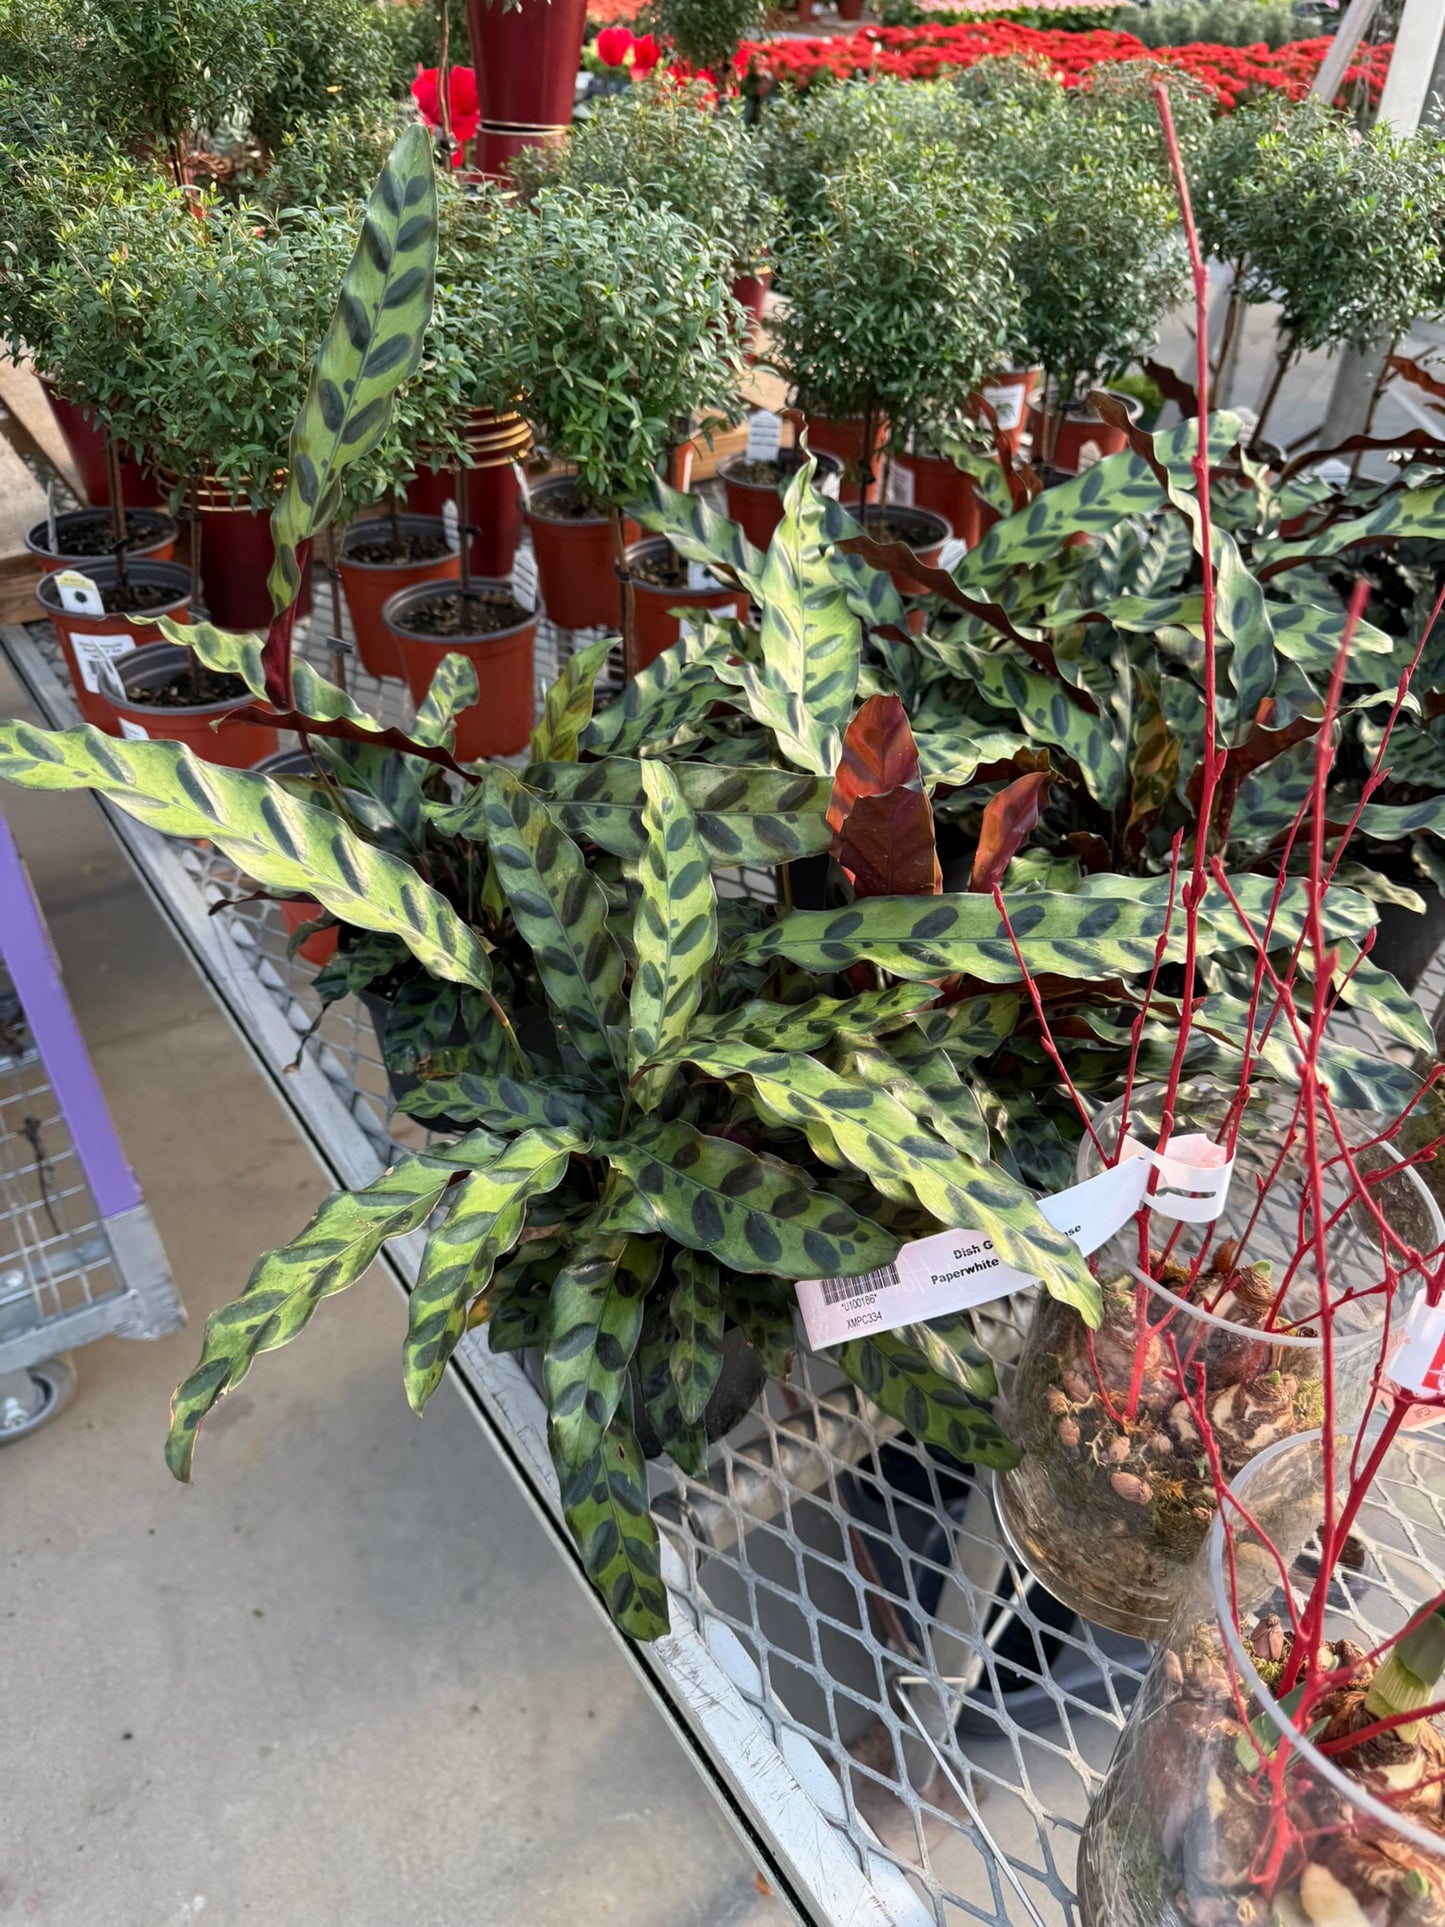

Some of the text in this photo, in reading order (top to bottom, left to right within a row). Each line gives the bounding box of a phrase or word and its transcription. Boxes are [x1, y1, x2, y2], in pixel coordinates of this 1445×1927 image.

[953, 1245, 981, 1259] Dish
[930, 1258, 1000, 1285] Paperwhite
[846, 1310, 883, 1330] XMPC334
